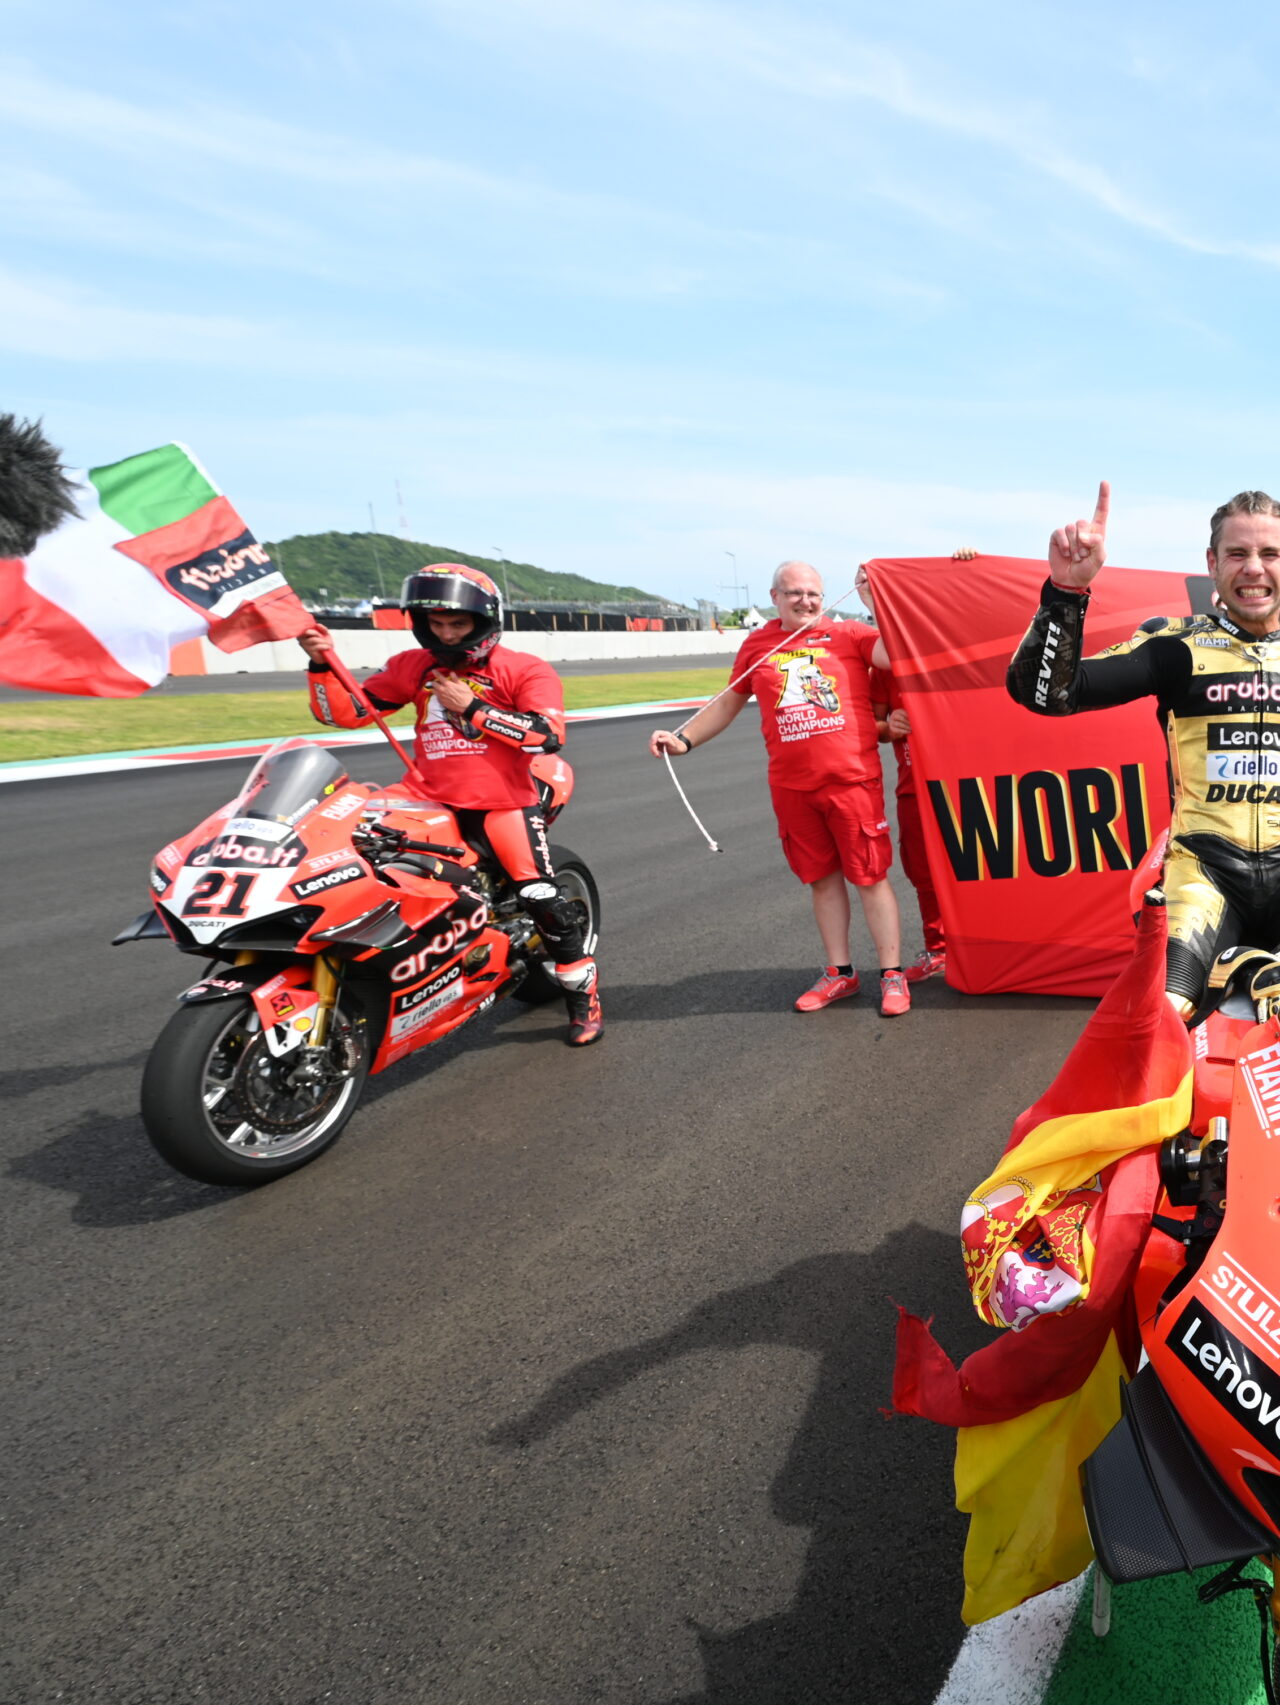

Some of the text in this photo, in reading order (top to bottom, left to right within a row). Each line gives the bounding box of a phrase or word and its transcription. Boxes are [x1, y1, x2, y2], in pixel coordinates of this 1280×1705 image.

[1035, 621, 1062, 707] REV'IT!
[775, 710, 817, 726] WORLD
[778, 715, 846, 736] CHAMPIONS
[485, 719, 524, 740] Lenovo
[423, 739, 489, 753] CHAMPIONS
[1234, 755, 1278, 777] riello
[295, 866, 361, 896] Lenovo
[180, 869, 262, 920] 21
[188, 920, 227, 929] DUCATI
[401, 965, 461, 1010] Lenovo
